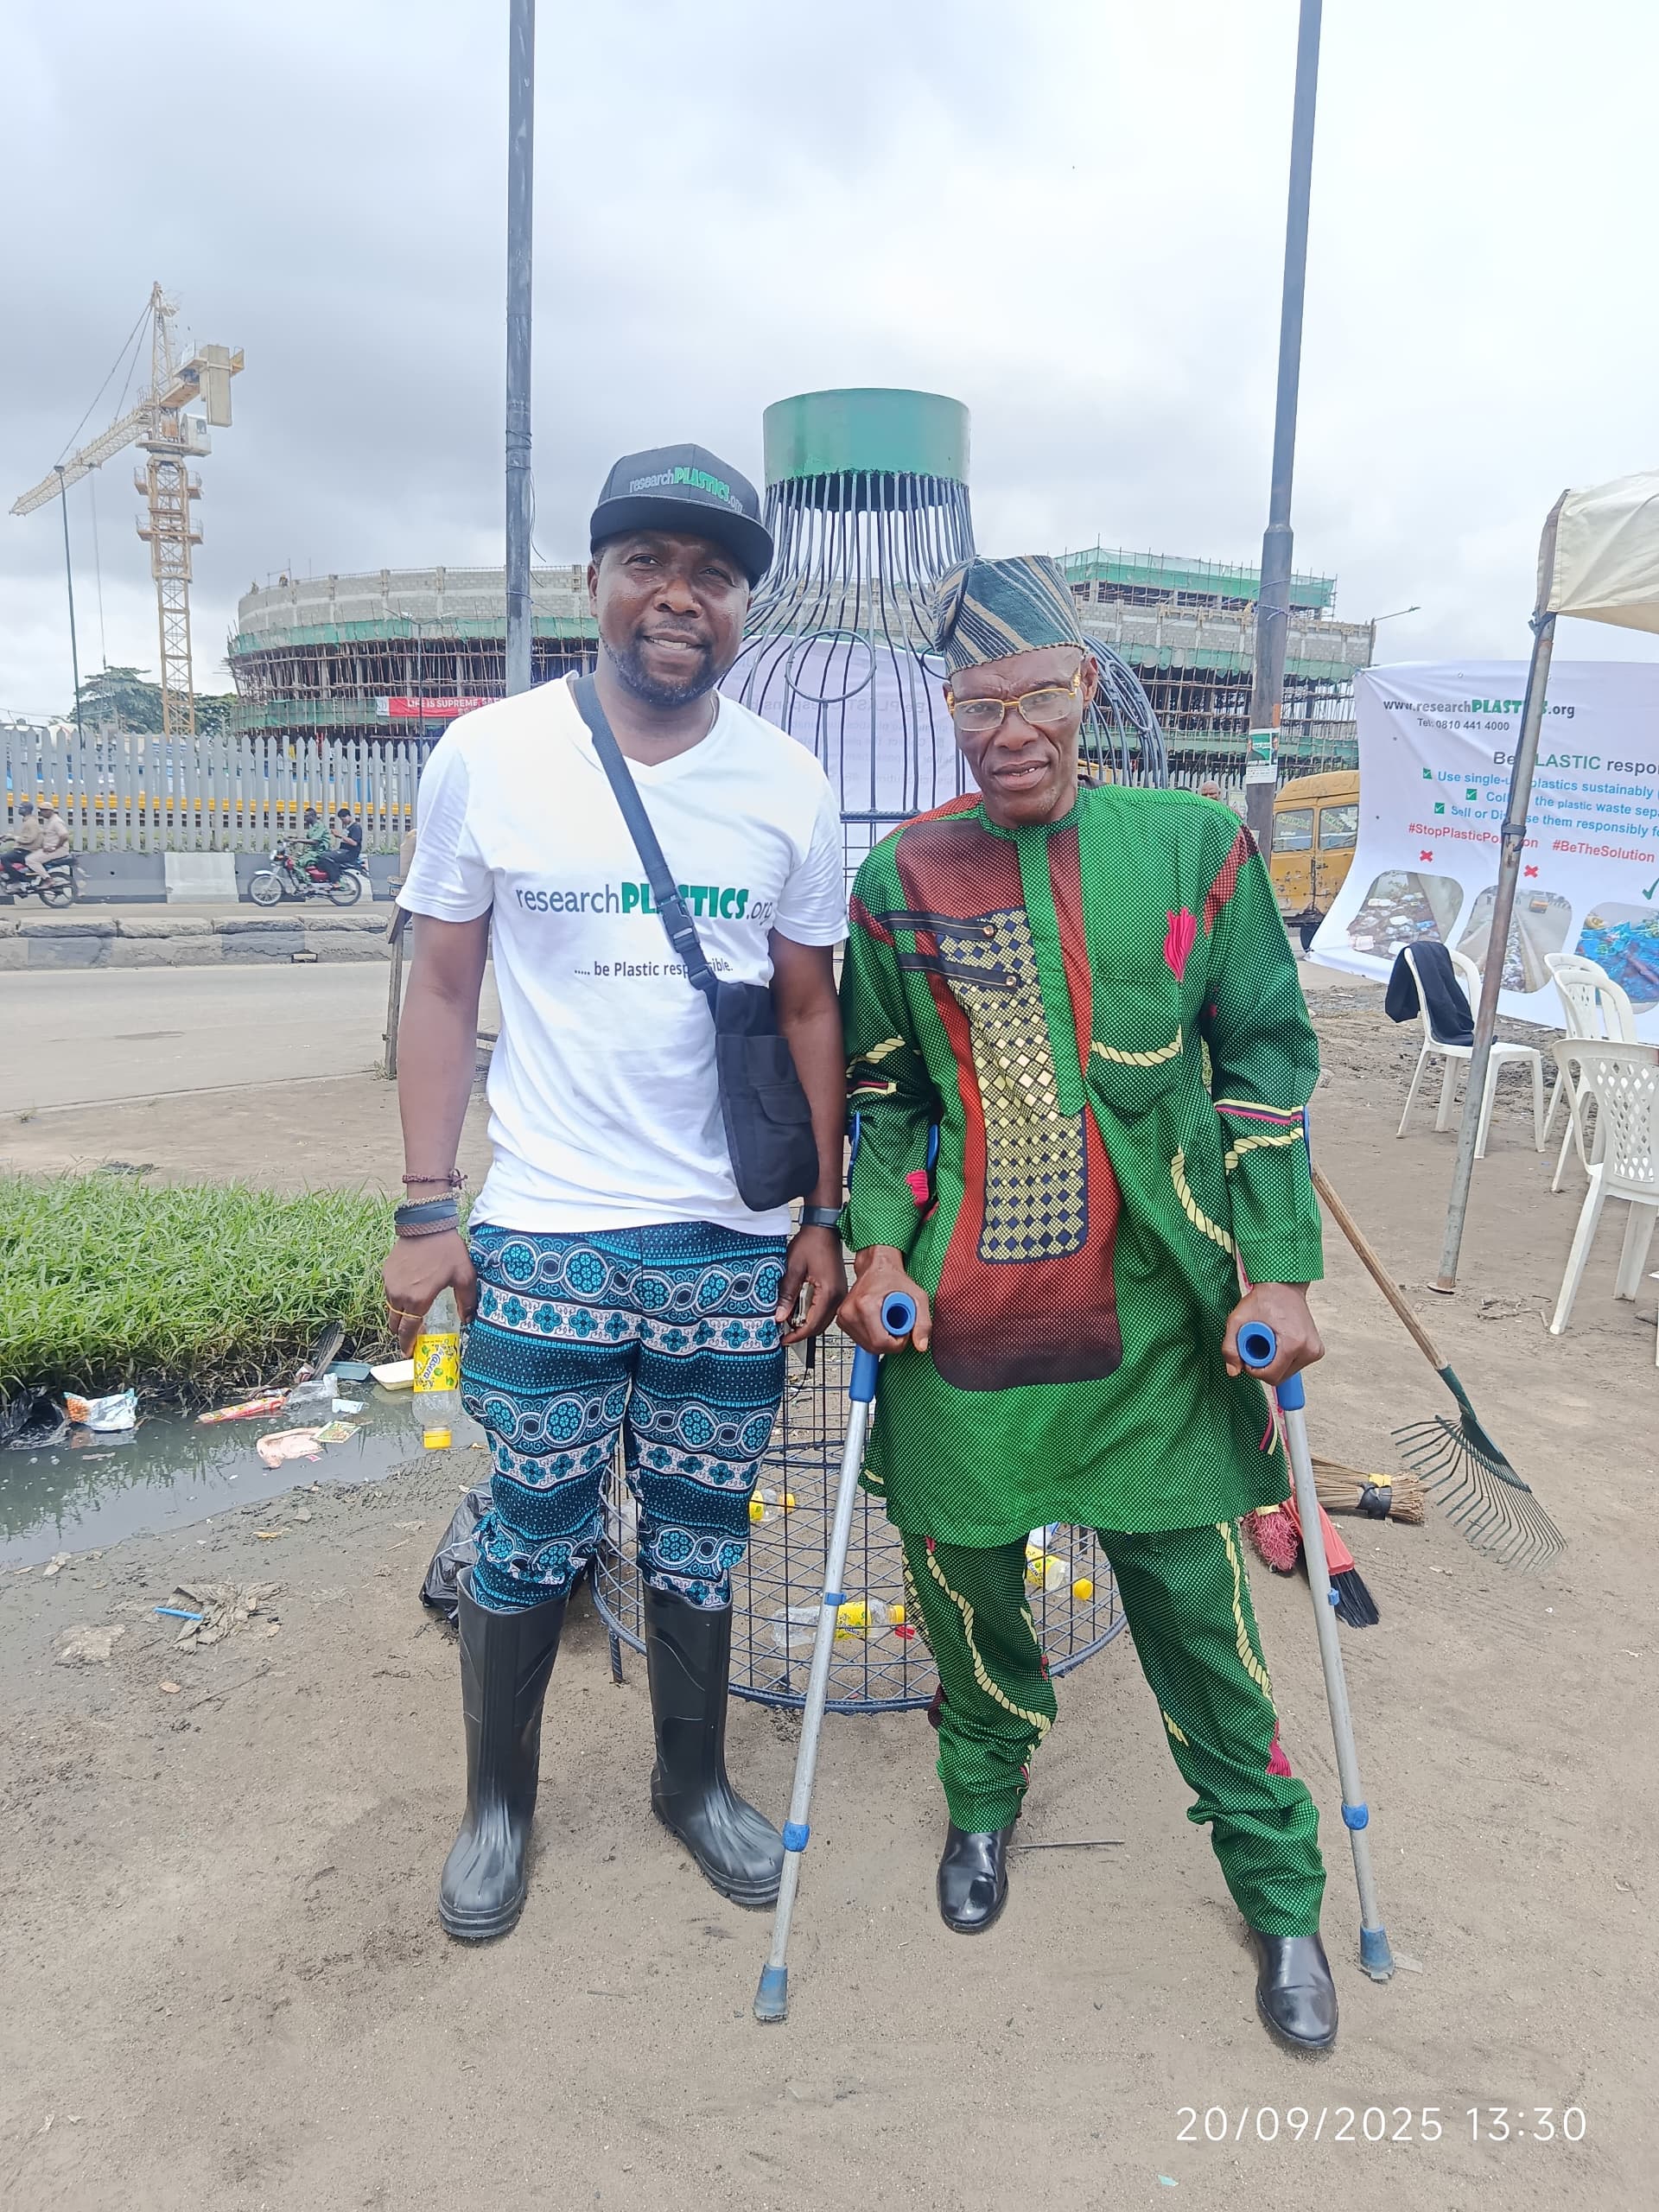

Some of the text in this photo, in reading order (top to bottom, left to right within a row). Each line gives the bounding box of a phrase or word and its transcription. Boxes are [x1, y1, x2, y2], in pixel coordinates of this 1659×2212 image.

[407, 698, 425, 708] LIFE
[427, 698, 435, 708] IS
[1436, 720, 1460, 729] 0810
[1463, 721, 1482, 730] 441
[1484, 721, 1510, 731] 4000
[1494, 751, 1659, 777] Be LASTIC respo
[1438, 771, 1461, 782] Use
[1581, 782, 1654, 800] sustainably
[1535, 795, 1554, 807] the
[1558, 798, 1592, 810] plastic
[1596, 803, 1631, 815] waste
[1635, 806, 1659, 820] sep
[1451, 805, 1470, 817] Sell
[1475, 810, 1488, 819] or
[1491, 809, 1539, 823] Dise
[1542, 815, 1573, 828] them
[1576, 819, 1649, 838] responsibly
[1408, 823, 1656, 862] #StopPlasticPoon #BeTheSolution
[594, 960, 610, 976] be
[614, 961, 659, 977] Plastic
[664, 957, 733, 978] respible.
